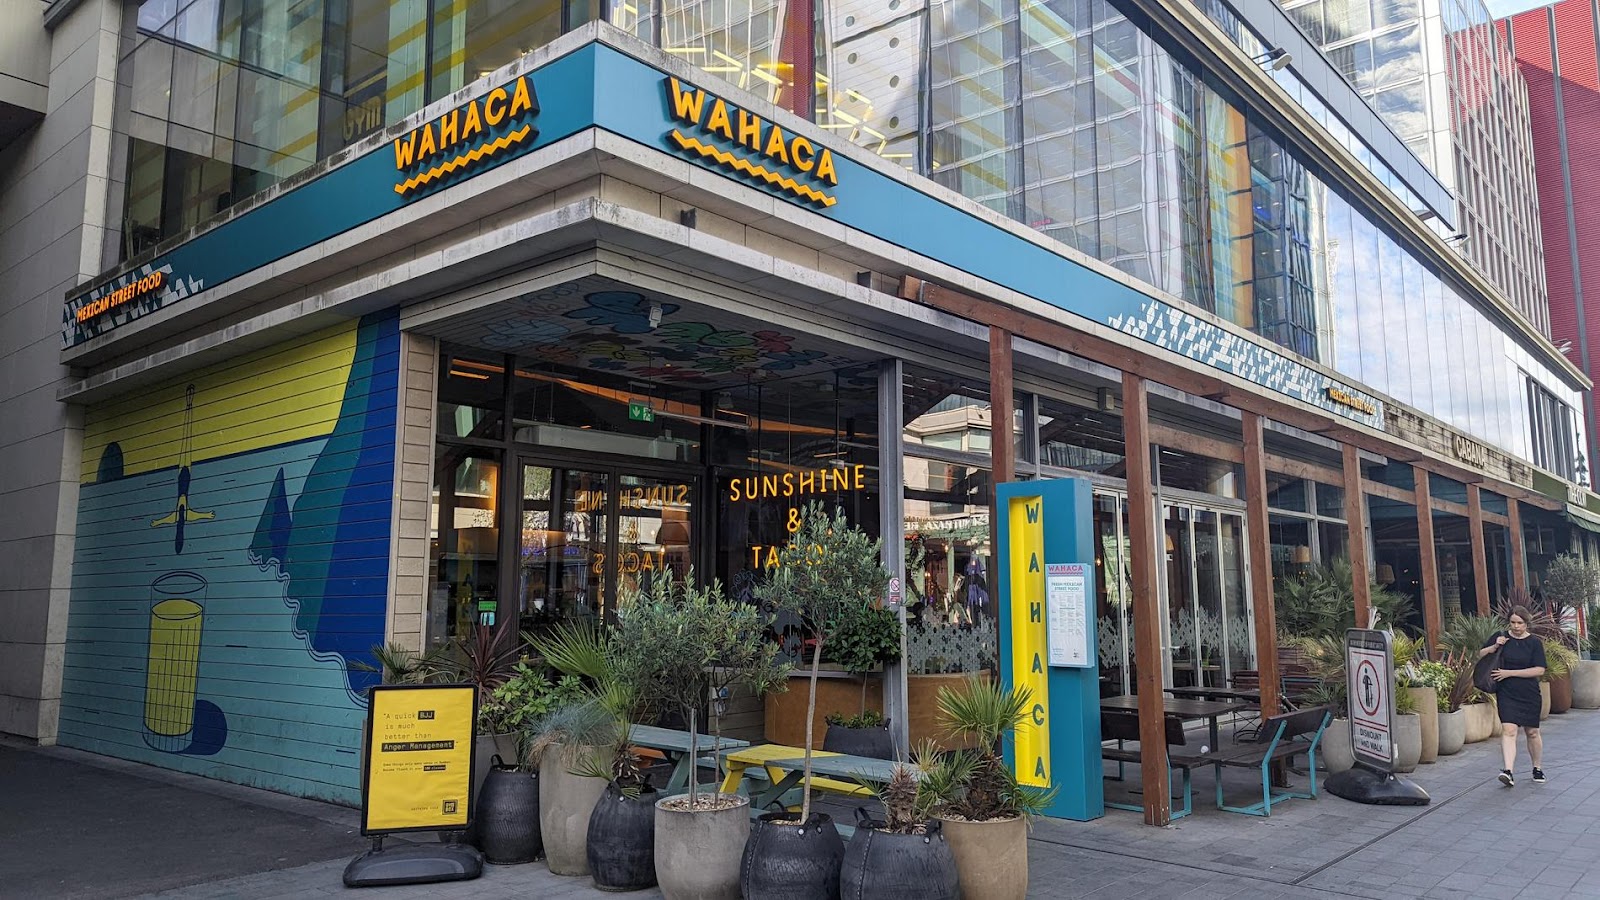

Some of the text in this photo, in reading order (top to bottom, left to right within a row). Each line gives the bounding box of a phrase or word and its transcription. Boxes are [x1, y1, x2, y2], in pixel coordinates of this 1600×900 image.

[393, 76, 534, 170] WAHACA
[667, 76, 838, 186] WAHACA
[76, 271, 162, 323] MEXICAN STREET FOOD
[1456, 435, 1486, 468] CABANA
[729, 464, 865, 502] SUNSHINE
[787, 507, 802, 533] &
[1025, 502, 1046, 780] WAHACA
[419, 711, 434, 719] BJJ
[383, 744, 406, 752] Anger
[1360, 728, 1382, 741] DISMOUNT
[1370, 742, 1384, 753] WALK
